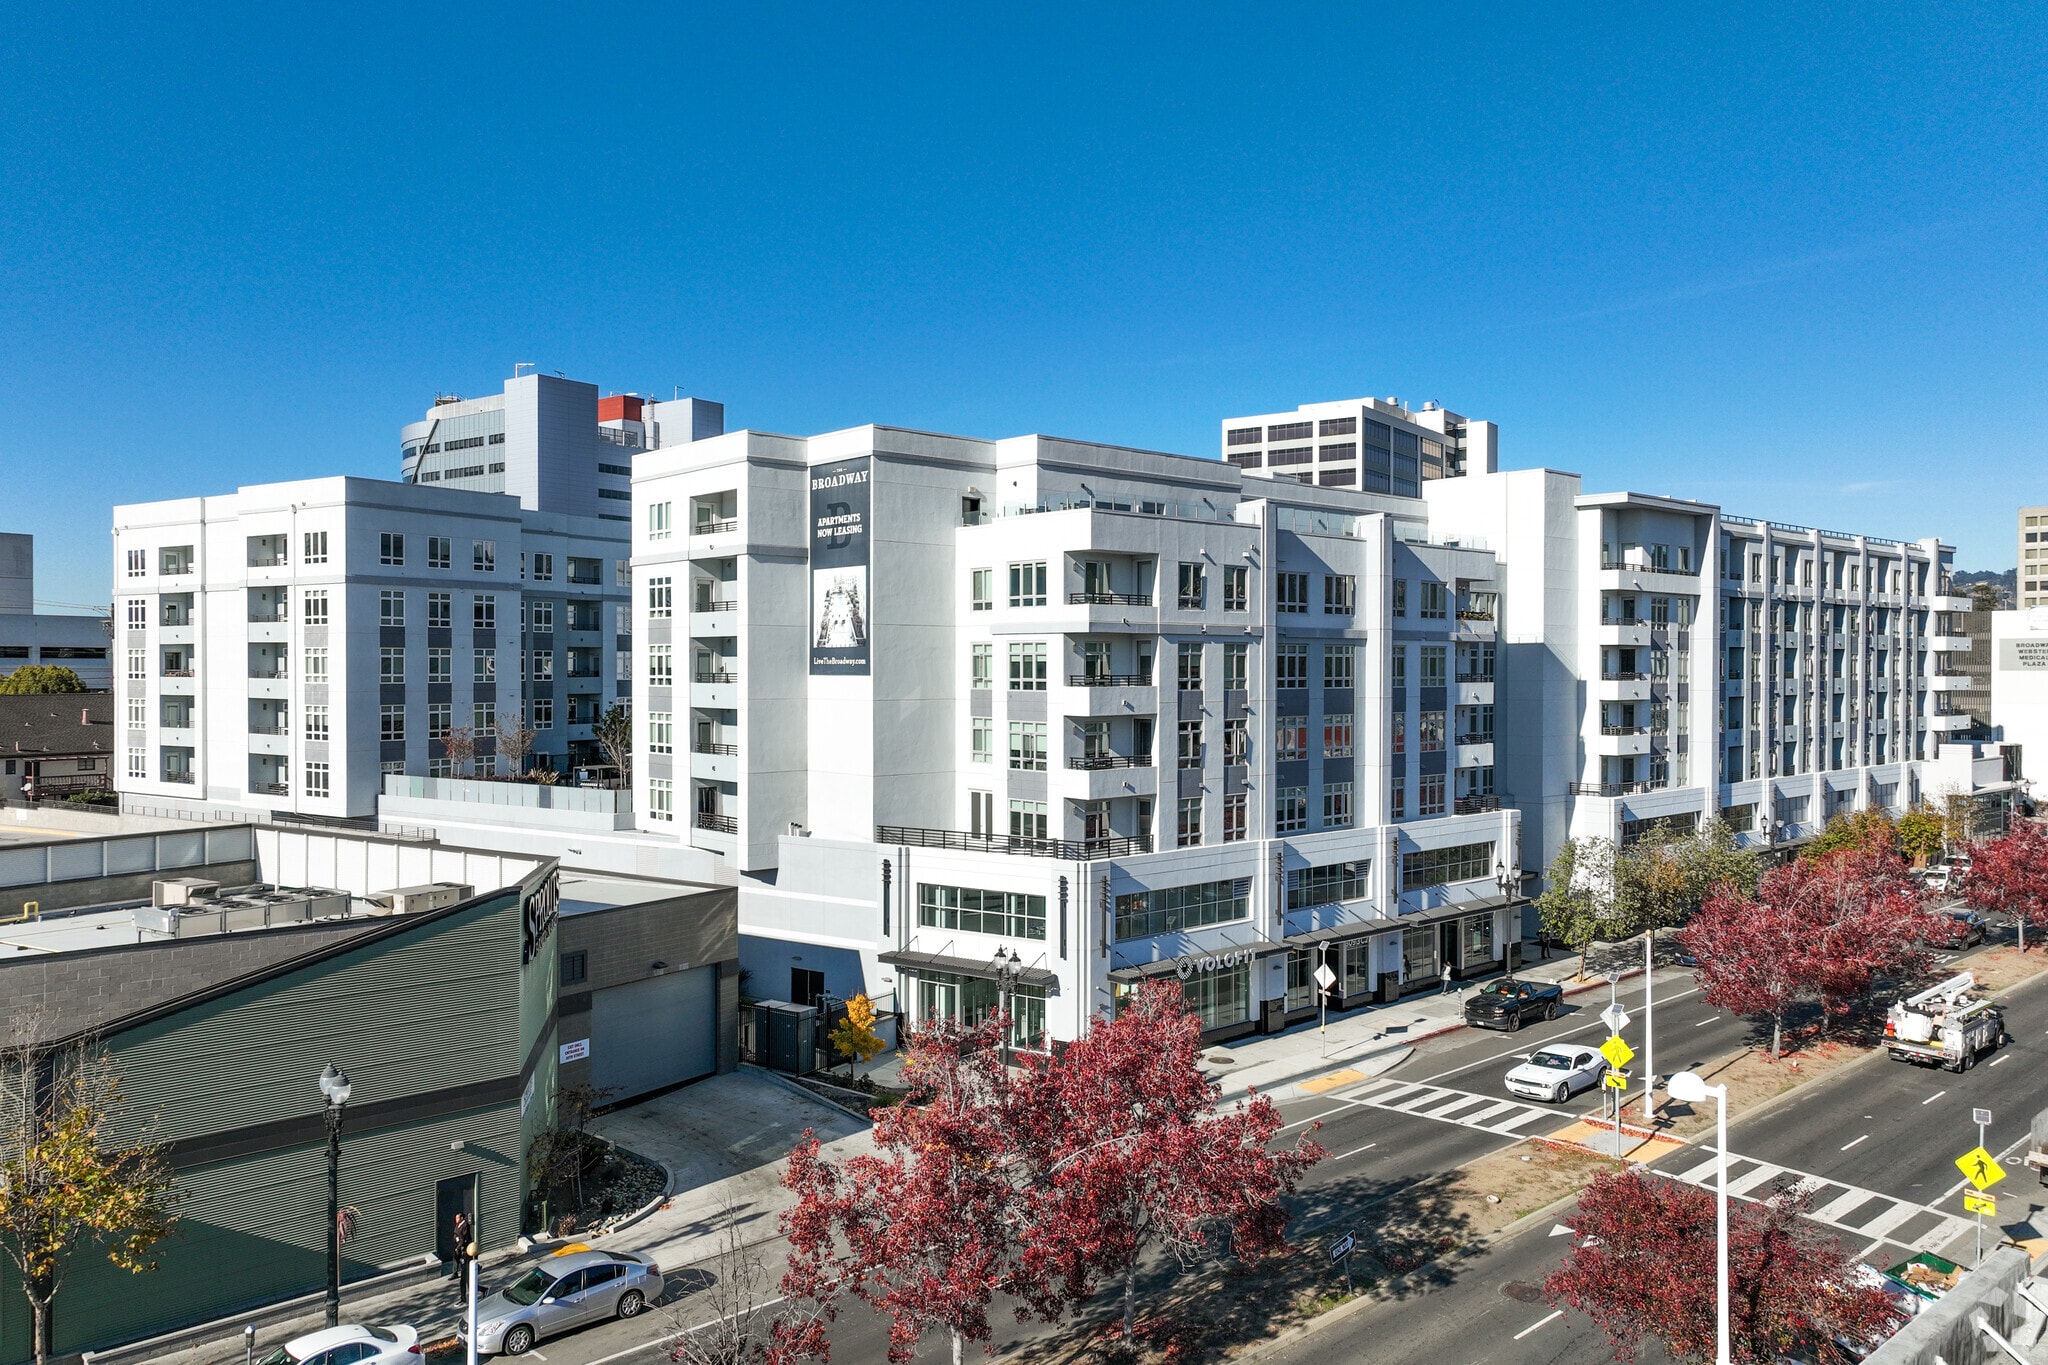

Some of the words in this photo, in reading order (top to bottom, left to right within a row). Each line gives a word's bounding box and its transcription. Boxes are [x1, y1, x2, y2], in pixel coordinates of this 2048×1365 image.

[812, 470, 869, 491] BROADWAY
[817, 512, 861, 527] APARTMENTS
[817, 527, 833, 538] NOW
[834, 524, 863, 536] LEASING
[813, 656, 867, 667] LiveTheBroadway.com
[1194, 947, 1258, 974] VOLOFIT
